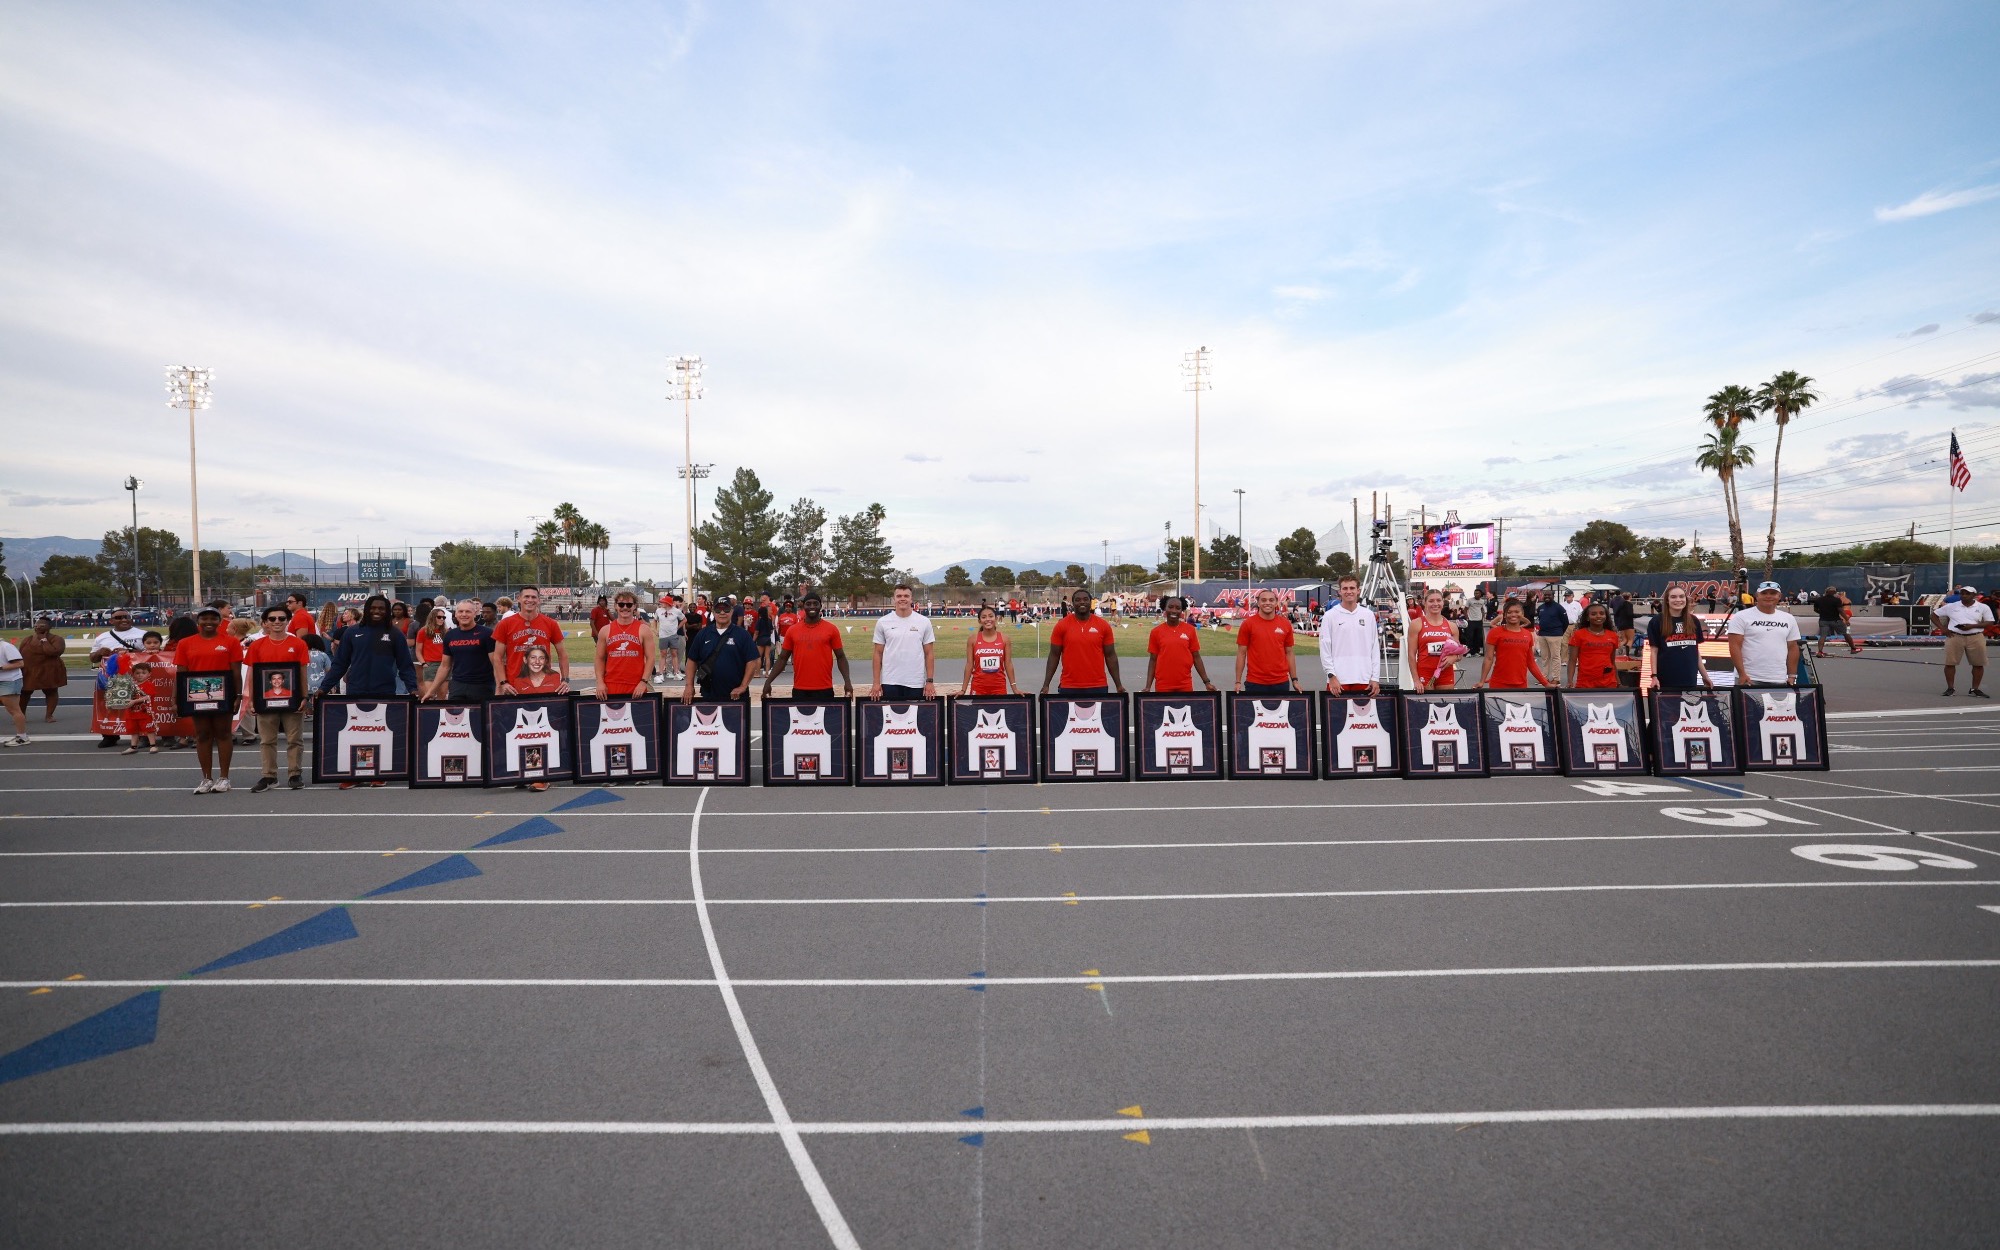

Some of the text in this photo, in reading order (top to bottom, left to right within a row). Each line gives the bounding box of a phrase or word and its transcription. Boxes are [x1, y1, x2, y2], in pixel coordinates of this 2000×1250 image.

[1751, 620, 1789, 629] ARIZONA
[449, 639, 480, 647] ARIZONA
[983, 658, 997, 667] 107
[155, 712, 177, 723] 2026
[1766, 715, 1797, 723] ARIZONA
[348, 724, 386, 732] ARIZONA
[1256, 721, 1289, 730] ARIZONA
[1505, 725, 1537, 733] ARIZONA
[602, 726, 633, 735] ARIZONA
[885, 728, 918, 736] ARIZONA
[1069, 727, 1101, 735] ARIZONA
[1428, 729, 1461, 737] ARIZONA
[1588, 727, 1620, 735] ARIZONA
[1680, 726, 1713, 734] ARIZONA
[440, 731, 471, 739] ARIZONA
[515, 732, 552, 741] ARIZONA
[976, 732, 1009, 740] ARIZONA
[1571, 779, 1694, 797] 4
[1659, 806, 1822, 828] 5
